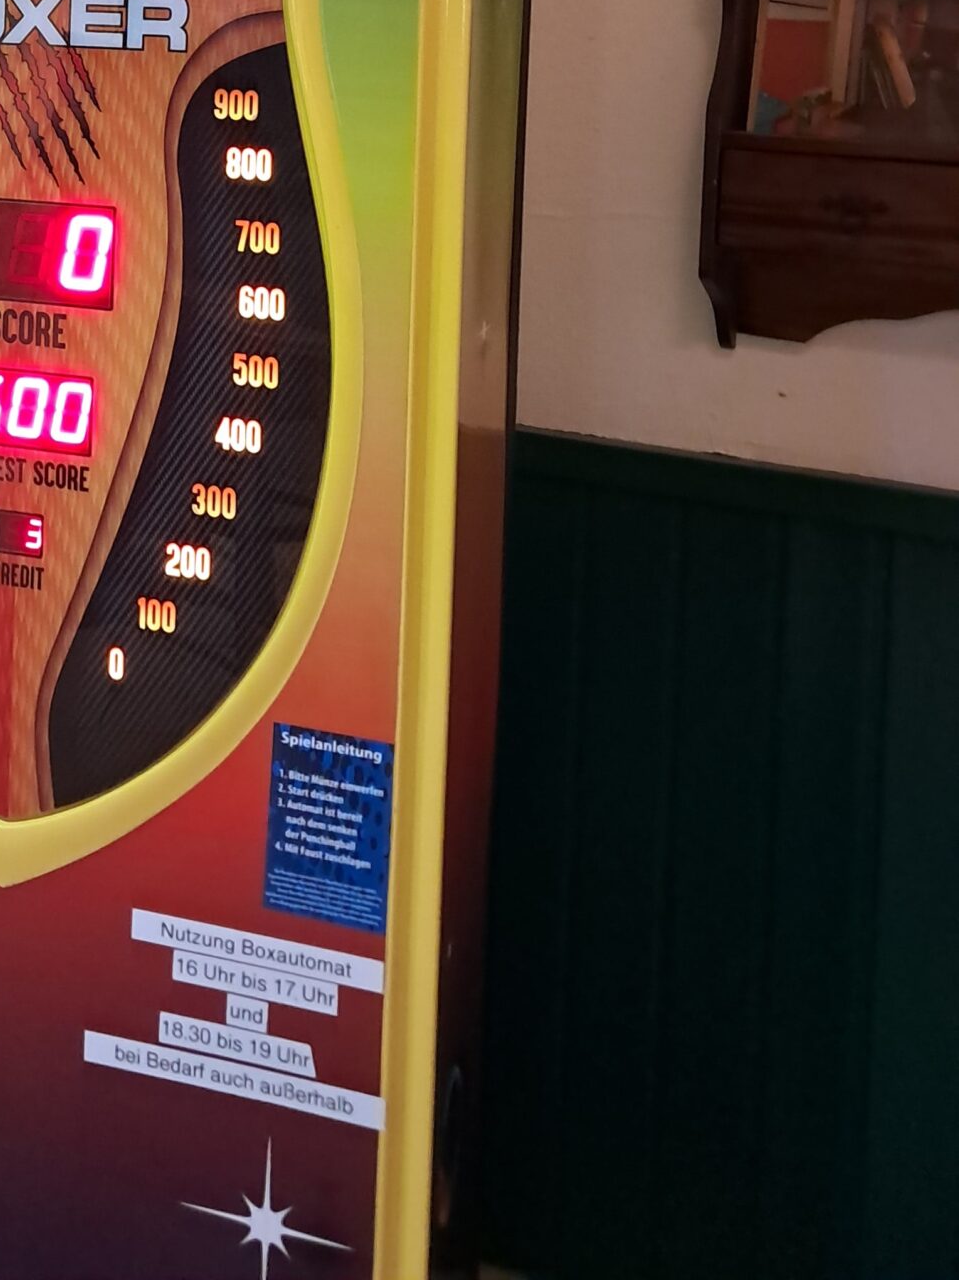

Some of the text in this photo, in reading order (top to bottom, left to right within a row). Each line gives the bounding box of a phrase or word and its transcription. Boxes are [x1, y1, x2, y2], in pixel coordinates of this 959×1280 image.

[213, 88, 259, 121] 900
[225, 147, 272, 182] 800
[59, 214, 114, 292] 0
[235, 219, 280, 255] 700
[238, 285, 285, 321] 600
[232, 352, 279, 390] 500
[214, 417, 262, 454] 400
[32, 463, 90, 493] SCORE
[191, 484, 237, 520] 300
[24, 520, 43, 550] 3
[165, 543, 211, 581] 200
[137, 597, 176, 633] 100
[108, 647, 125, 681] 0
[281, 731, 383, 764] Spielanleitung
[287, 785, 309, 797] Start
[325, 807, 336, 818] ist
[161, 922, 352, 978] Nutzung Boxautomat
[177, 958, 335, 1007] 16 Uhr bis 17 Uhr
[230, 1002, 264, 1025] und
[163, 1020, 310, 1068] 18.30 bis 19 Uhr
[114, 1044, 354, 1115] bei Bedarf auch außerhalb
